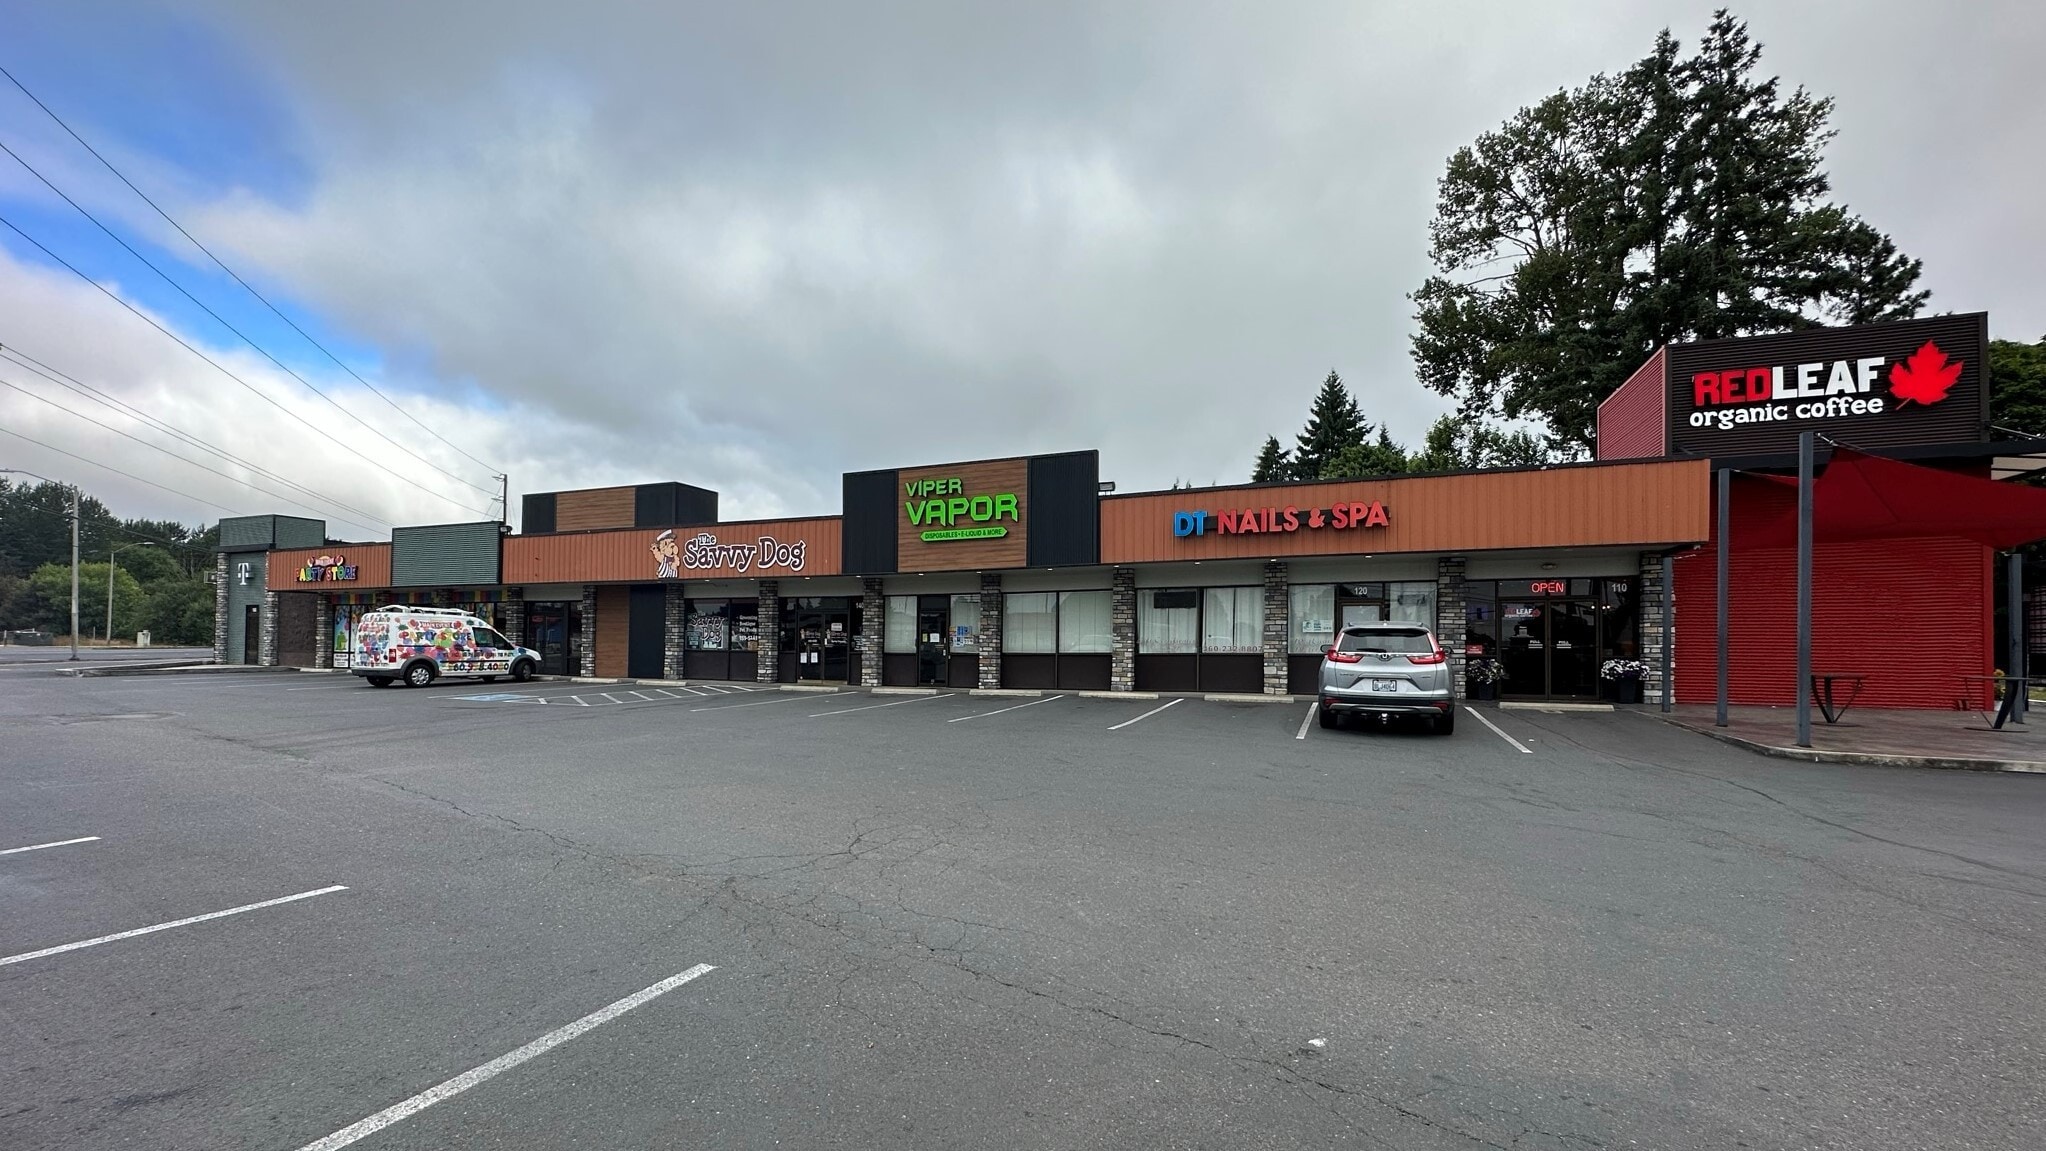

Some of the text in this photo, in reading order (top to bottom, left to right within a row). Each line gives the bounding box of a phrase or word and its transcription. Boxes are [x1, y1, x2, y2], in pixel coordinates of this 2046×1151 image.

[1694, 356, 1885, 407] REDLEAF
[1689, 396, 1884, 430] organic coffee
[905, 478, 962, 498] VIPER
[905, 493, 1018, 527] VAPOR
[1174, 500, 1389, 537] DT NAILS & SPA
[698, 533, 717, 546] The
[987, 528, 1002, 536] MORE
[683, 536, 806, 572] Savvy Dog
[237, 562, 250, 585] T
[294, 565, 357, 582] PARTY STORE
[1354, 586, 1368, 596] 120
[1531, 582, 1564, 594] OPEN
[1611, 583, 1628, 593] 110
[438, 632, 472, 641] STORE
